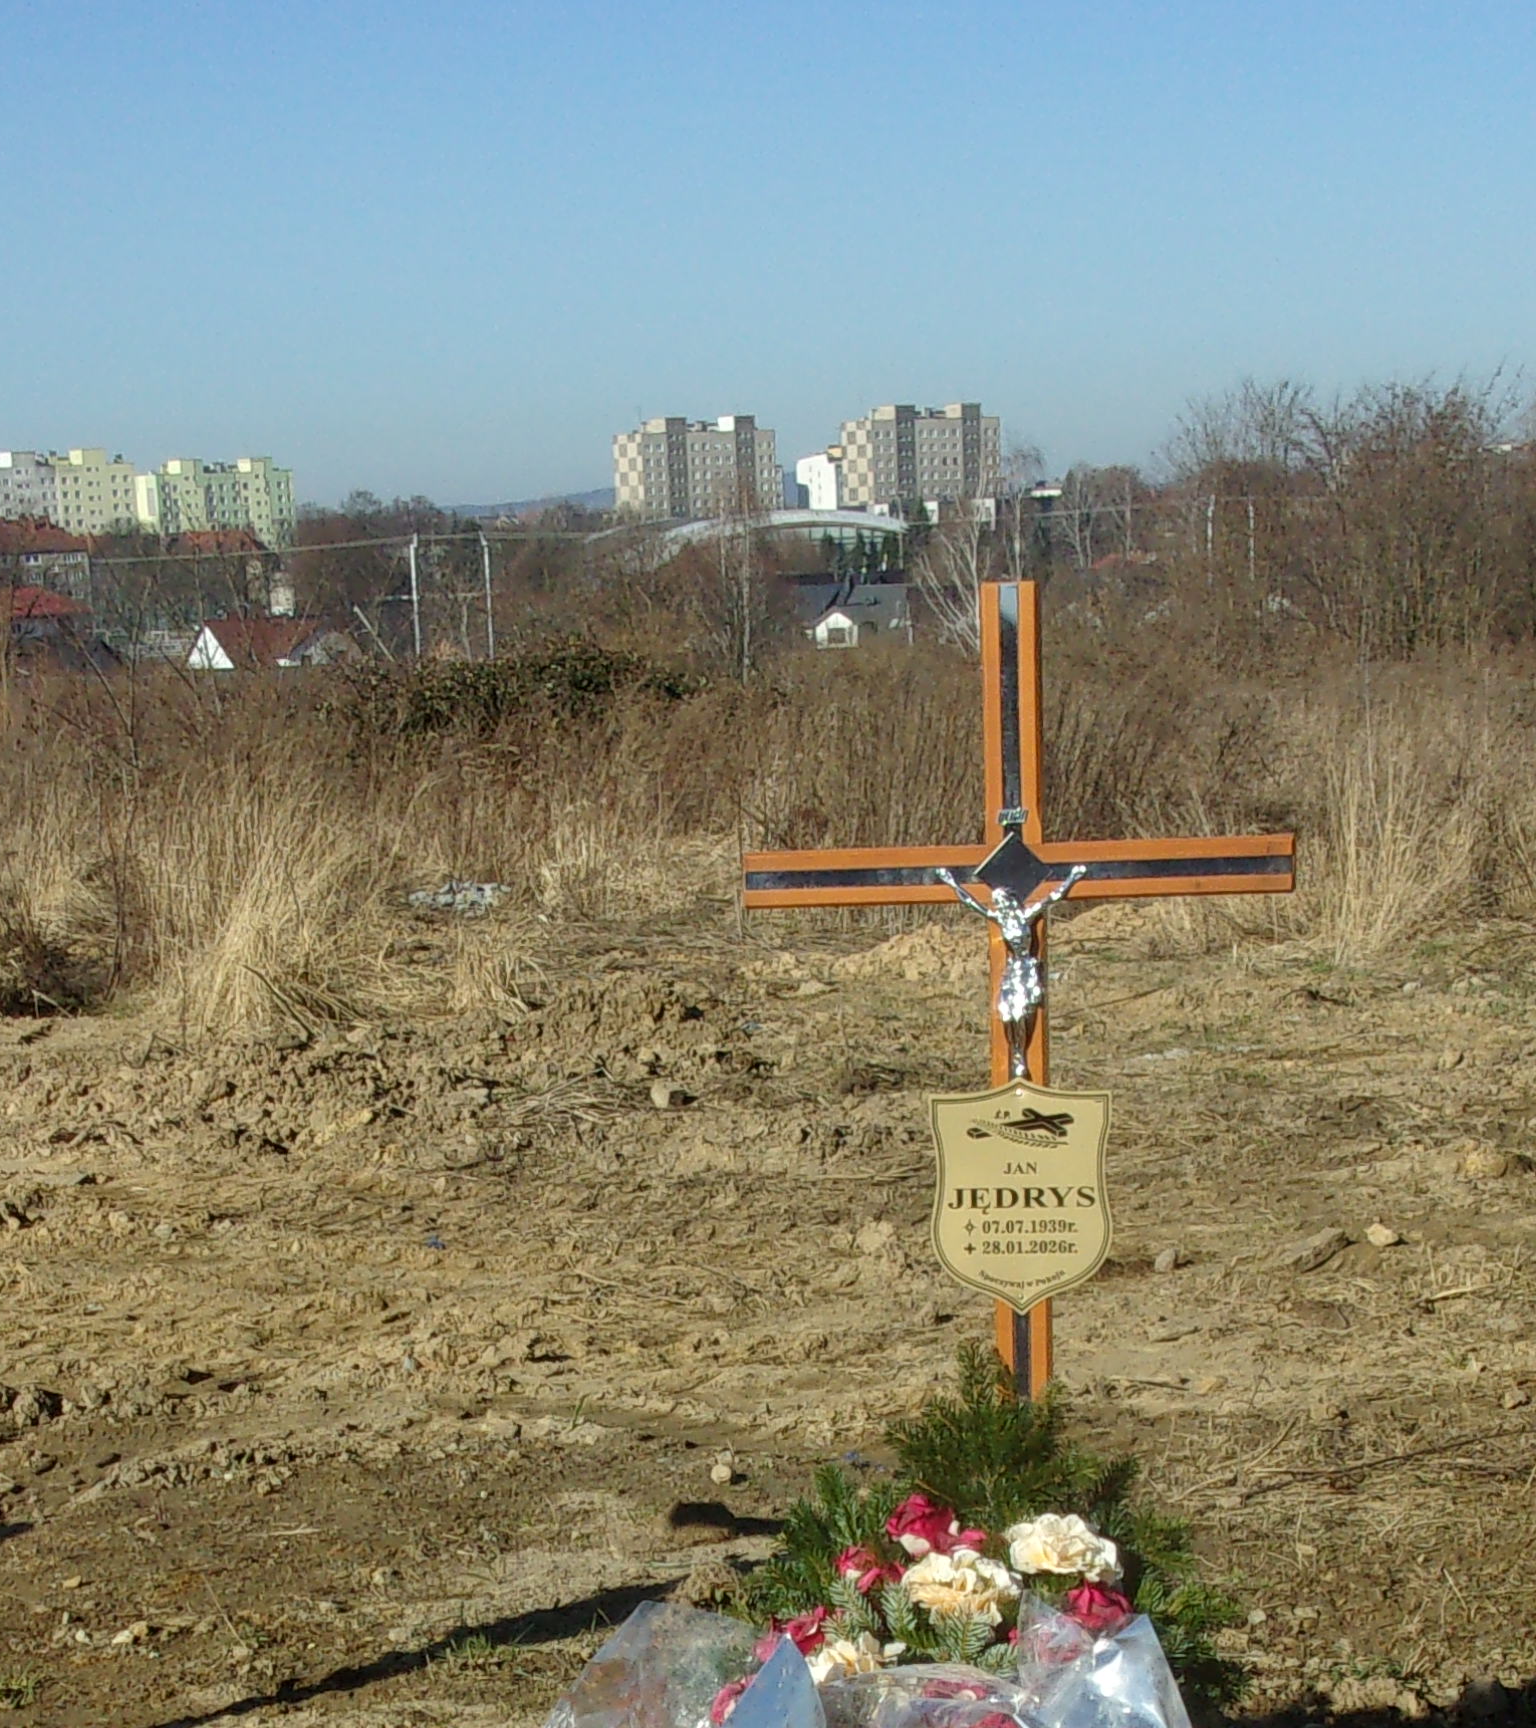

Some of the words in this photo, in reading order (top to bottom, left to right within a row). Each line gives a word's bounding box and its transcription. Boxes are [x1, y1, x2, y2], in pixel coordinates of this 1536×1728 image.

[1002, 1162, 1038, 1175] JAN
[947, 1186, 1096, 1215] JĘDRYS
[981, 1219, 1079, 1234] 07.07.1939r.
[981, 1240, 1079, 1255] 28.01.2026r.
